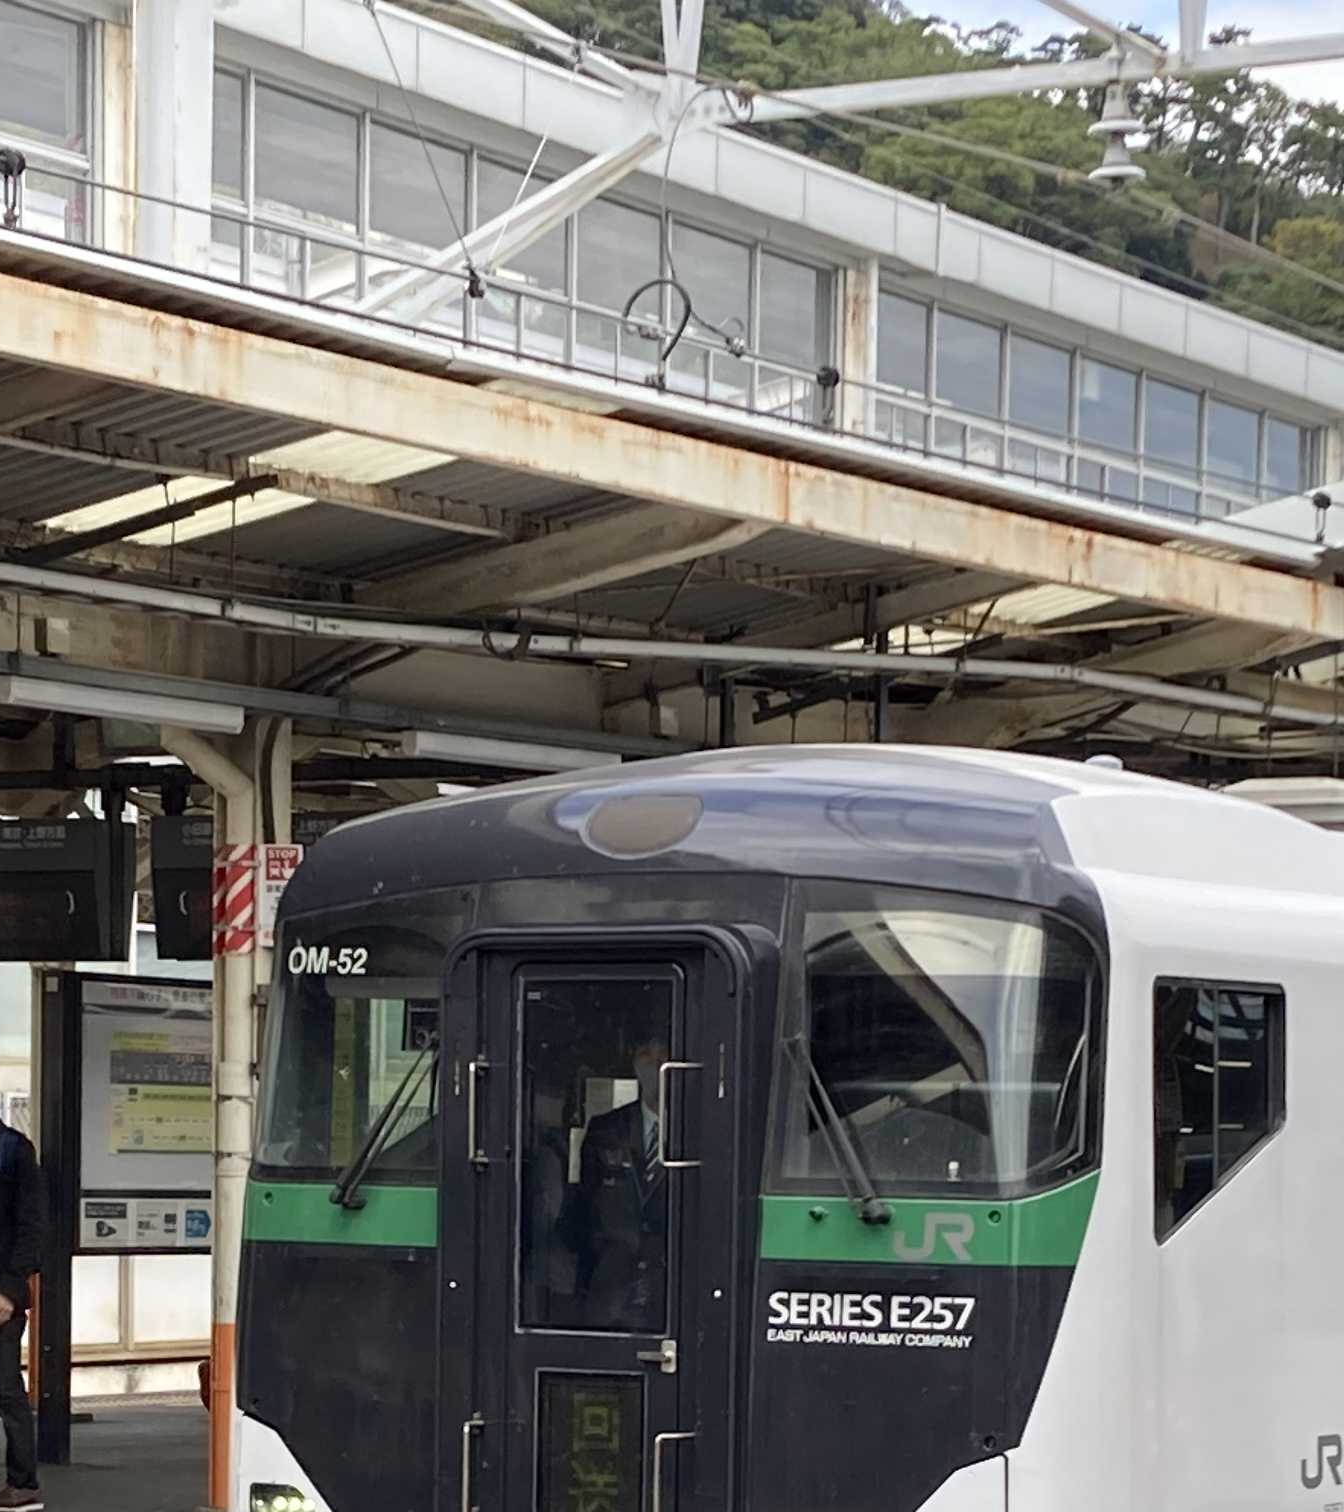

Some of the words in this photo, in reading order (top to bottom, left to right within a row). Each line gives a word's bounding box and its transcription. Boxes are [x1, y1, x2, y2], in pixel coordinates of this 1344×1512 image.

[268, 848, 298, 859] STOP
[288, 946, 368, 975] OM-52
[892, 1212, 975, 1262] JR
[767, 1291, 883, 1328] SERIES
[890, 1295, 976, 1331] E257
[766, 1328, 803, 1342] EAST
[803, 1329, 848, 1344] JAPAN
[849, 1331, 904, 1347] RAILWAY
[905, 1333, 973, 1348] COMPANY
[1301, 1433, 1343, 1490] JR
